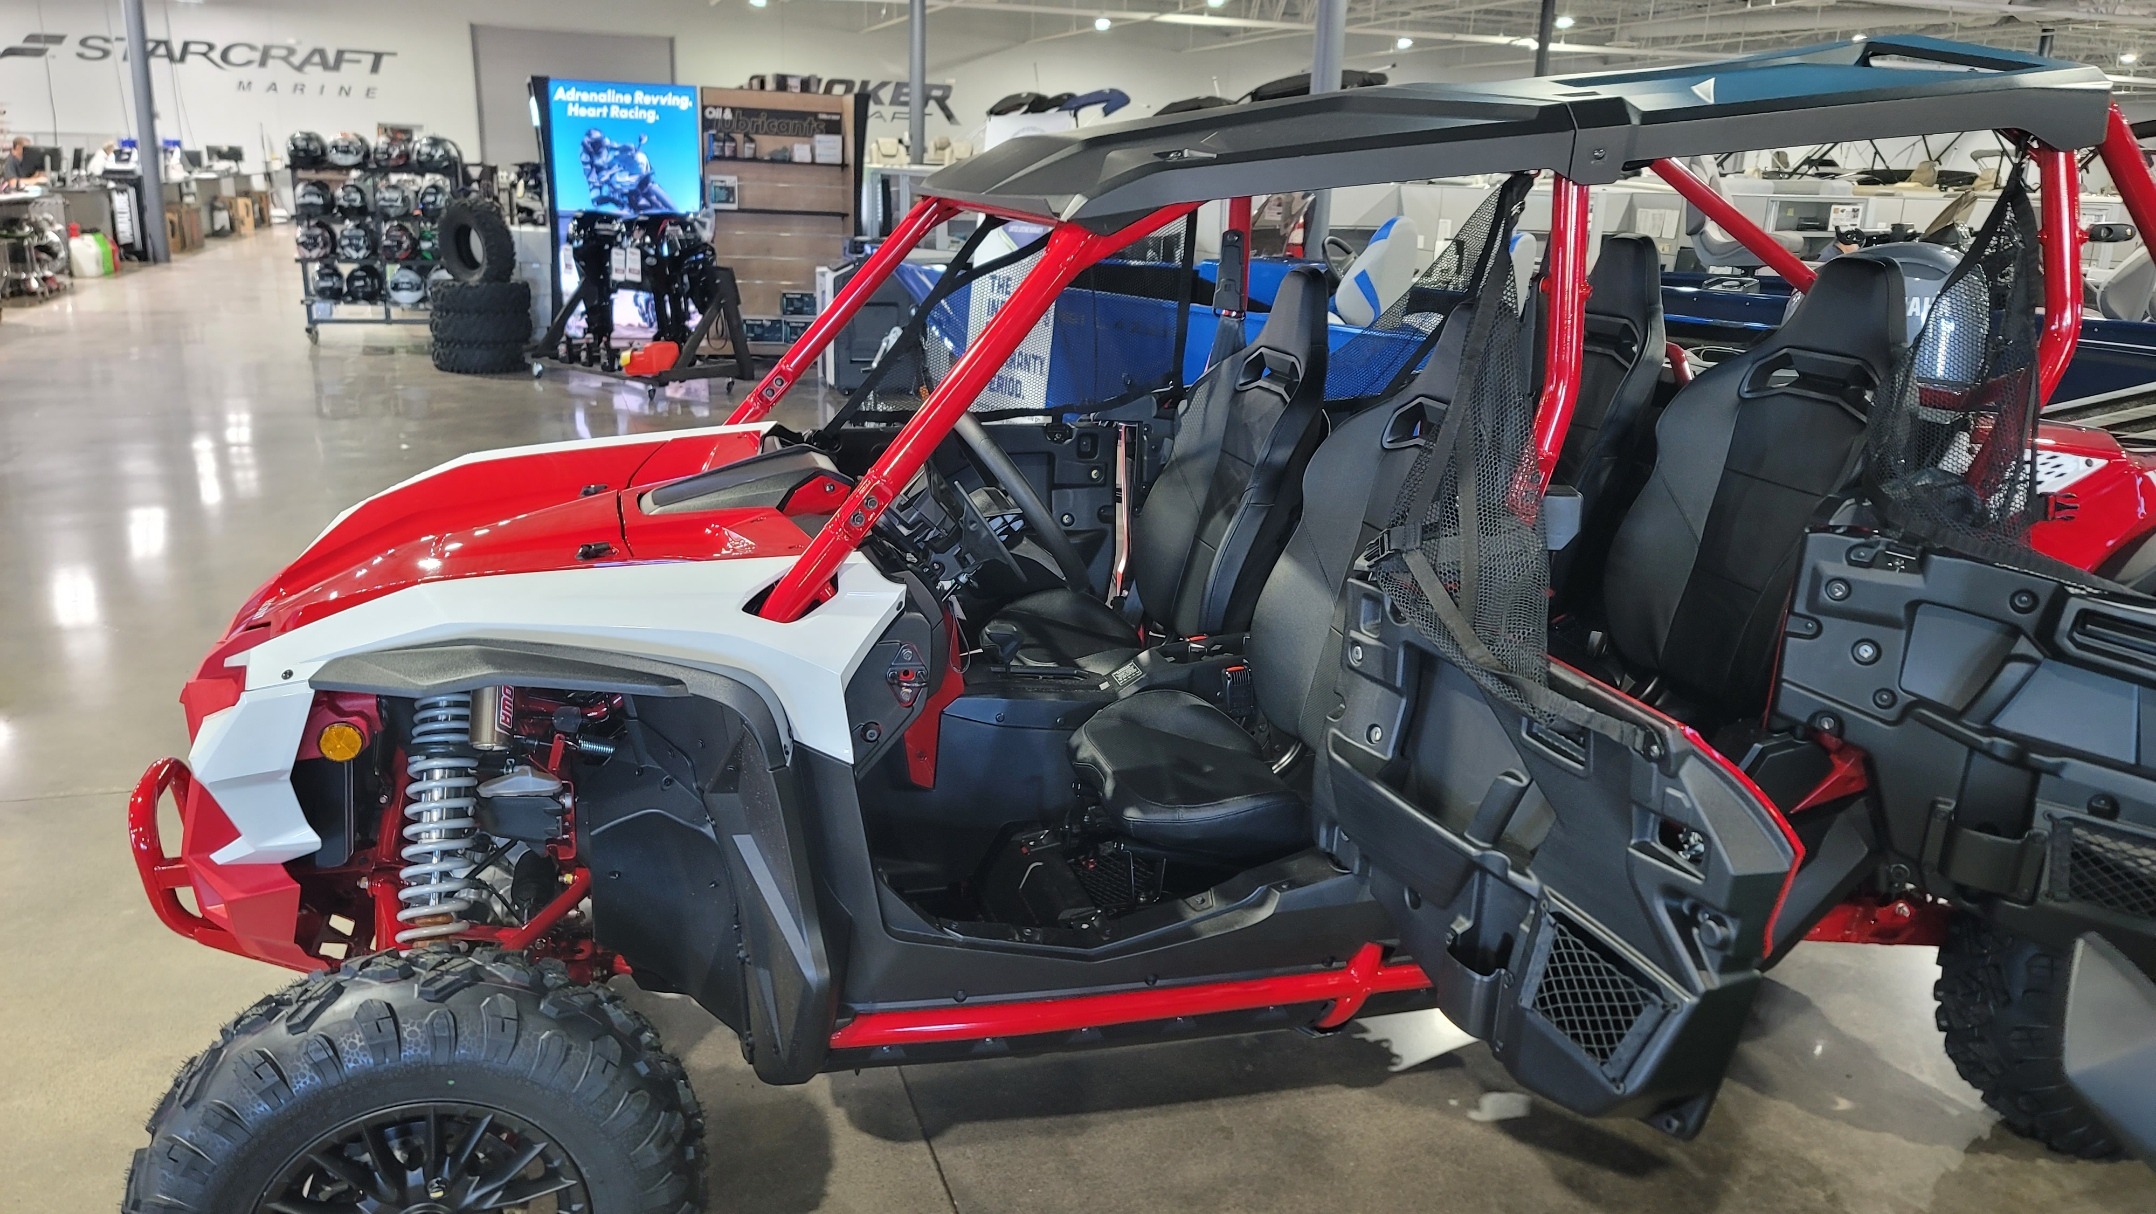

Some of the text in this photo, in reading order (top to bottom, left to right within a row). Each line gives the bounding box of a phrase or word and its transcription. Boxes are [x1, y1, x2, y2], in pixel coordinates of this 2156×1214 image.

[76, 35, 397, 75] STARCRAFT
[237, 80, 378, 99] MARINE
[553, 86, 693, 111] Adrenaline Revving.
[567, 102, 660, 123] Heart Racing.
[704, 106, 732, 120] Oil &
[990, 274, 1012, 296] THE
[988, 374, 1025, 400] ERIOD.
[500, 685, 514, 729] OWA
